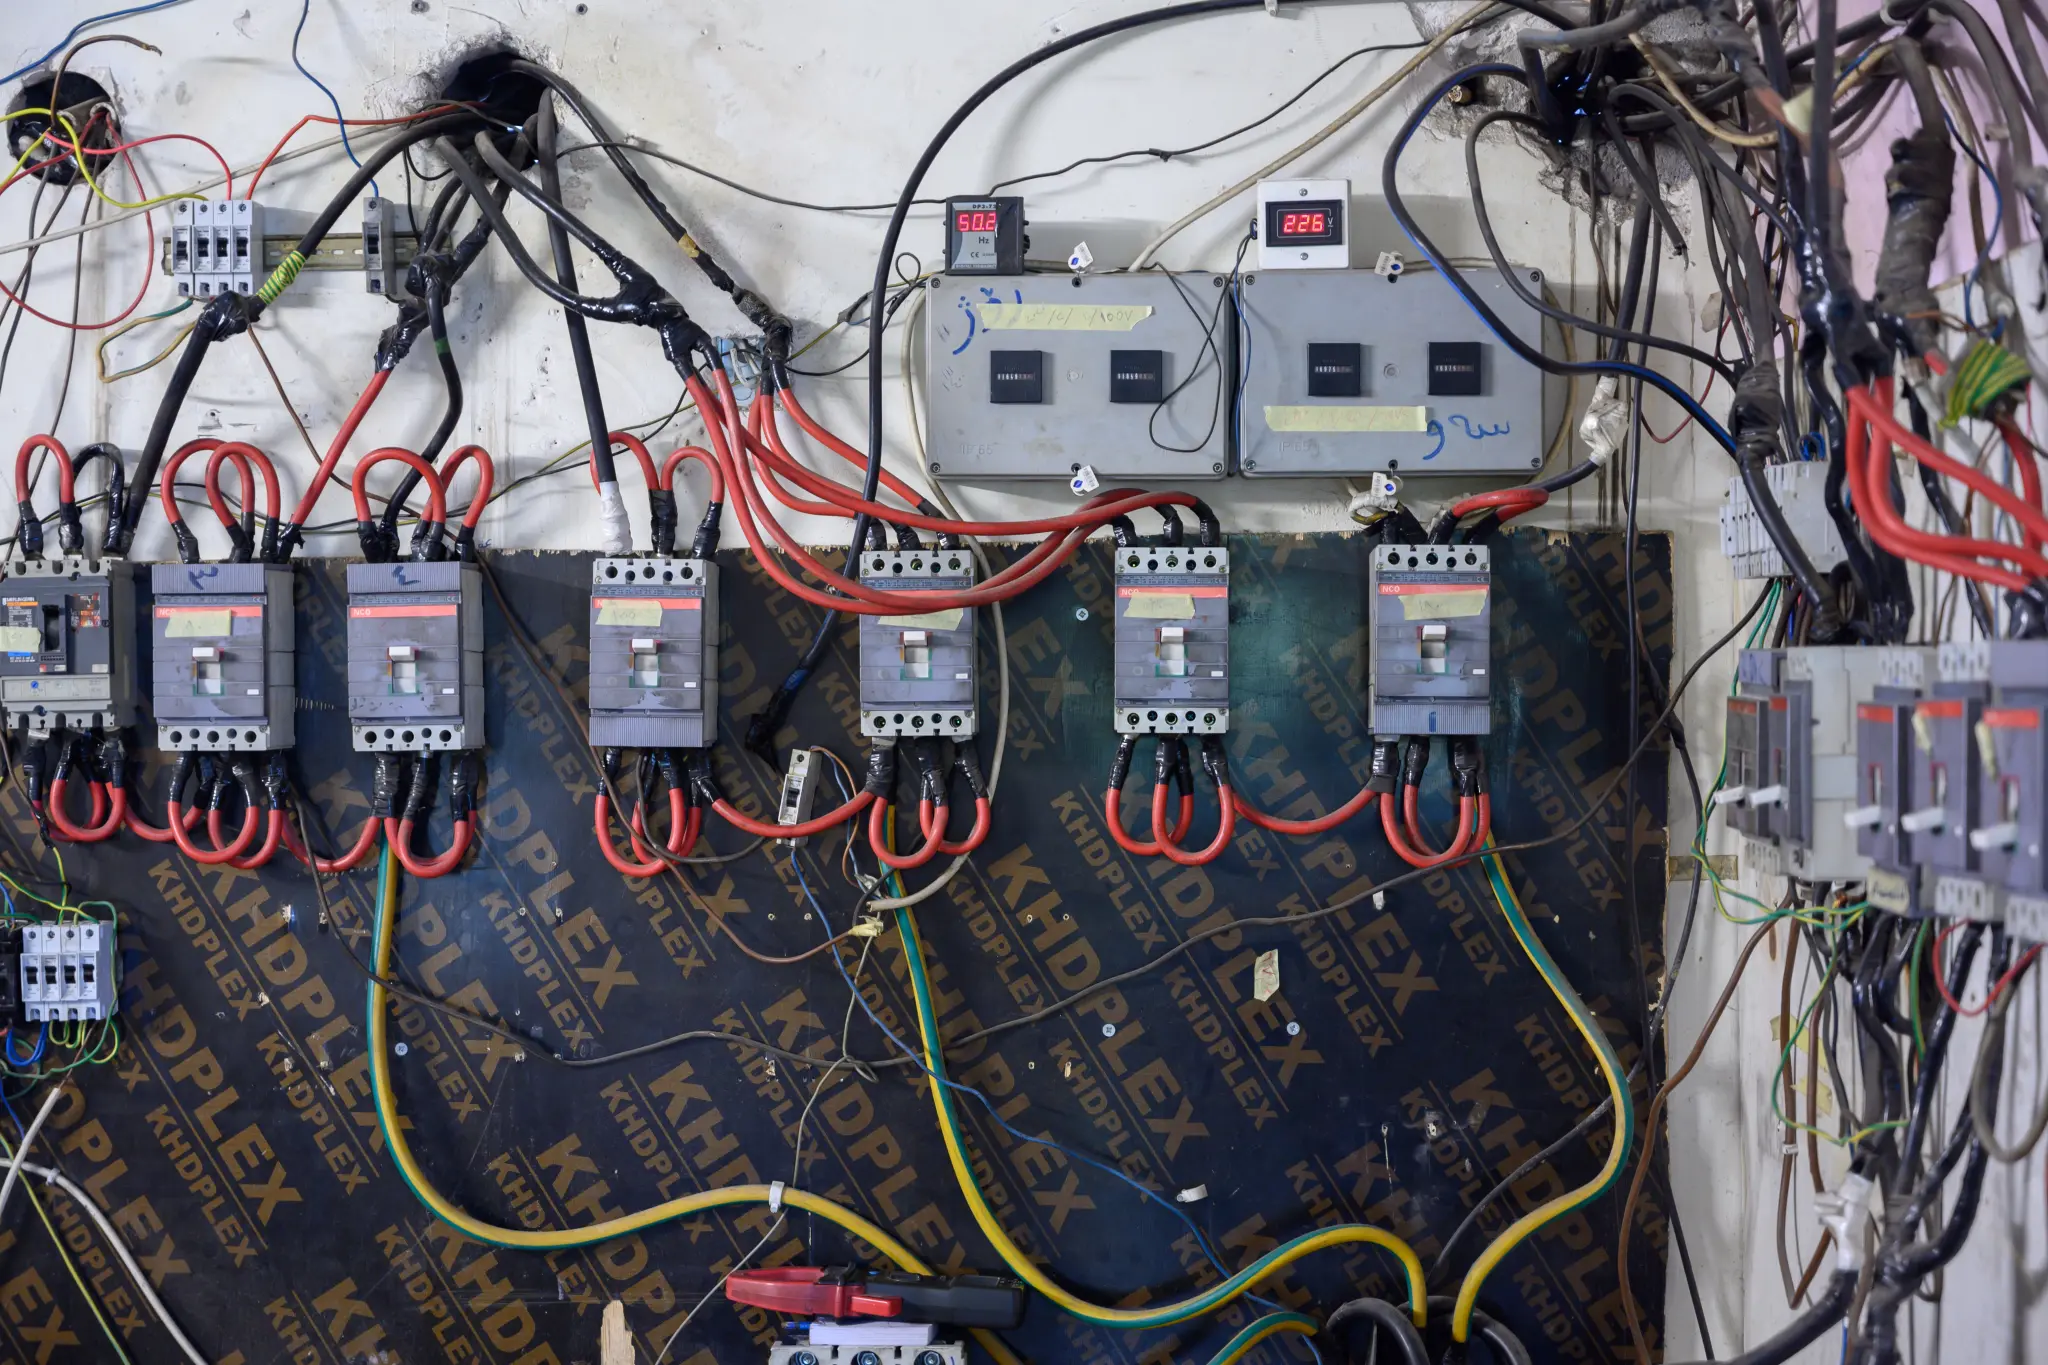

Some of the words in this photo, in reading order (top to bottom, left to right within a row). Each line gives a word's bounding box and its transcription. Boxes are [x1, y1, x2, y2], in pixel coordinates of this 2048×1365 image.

[959, 212, 997, 232] 50.2
[978, 236, 990, 245] Hz
[1283, 213, 1325, 234] 226
[353, 607, 371, 617] NCO
[1382, 585, 1401, 594] NCO
[702, 742, 819, 908] KHDLEX
[1049, 788, 1167, 956] KHDPLEX
[145, 857, 262, 1023] KHDPLEX
[478, 886, 594, 1052] KHDPLEX
[984, 841, 1211, 1162] KHDPLEX
[1275, 891, 1394, 1059] KHDPLEX
[253, 1030, 371, 1197] KHDPLEX
[710, 1005, 828, 1173] KHDPLEX
[1046, 1036, 1165, 1205] KHDPLEX
[1160, 963, 1279, 1132] KHDPLEX
[142, 1102, 260, 1268] KHDPLEX
[484, 1150, 602, 1317] KHDLEX
[597, 1078, 715, 1245] KHDPLX
[36, 1180, 146, 1339] KHDPLEX
[374, 1223, 482, 1365] KHDPLE
